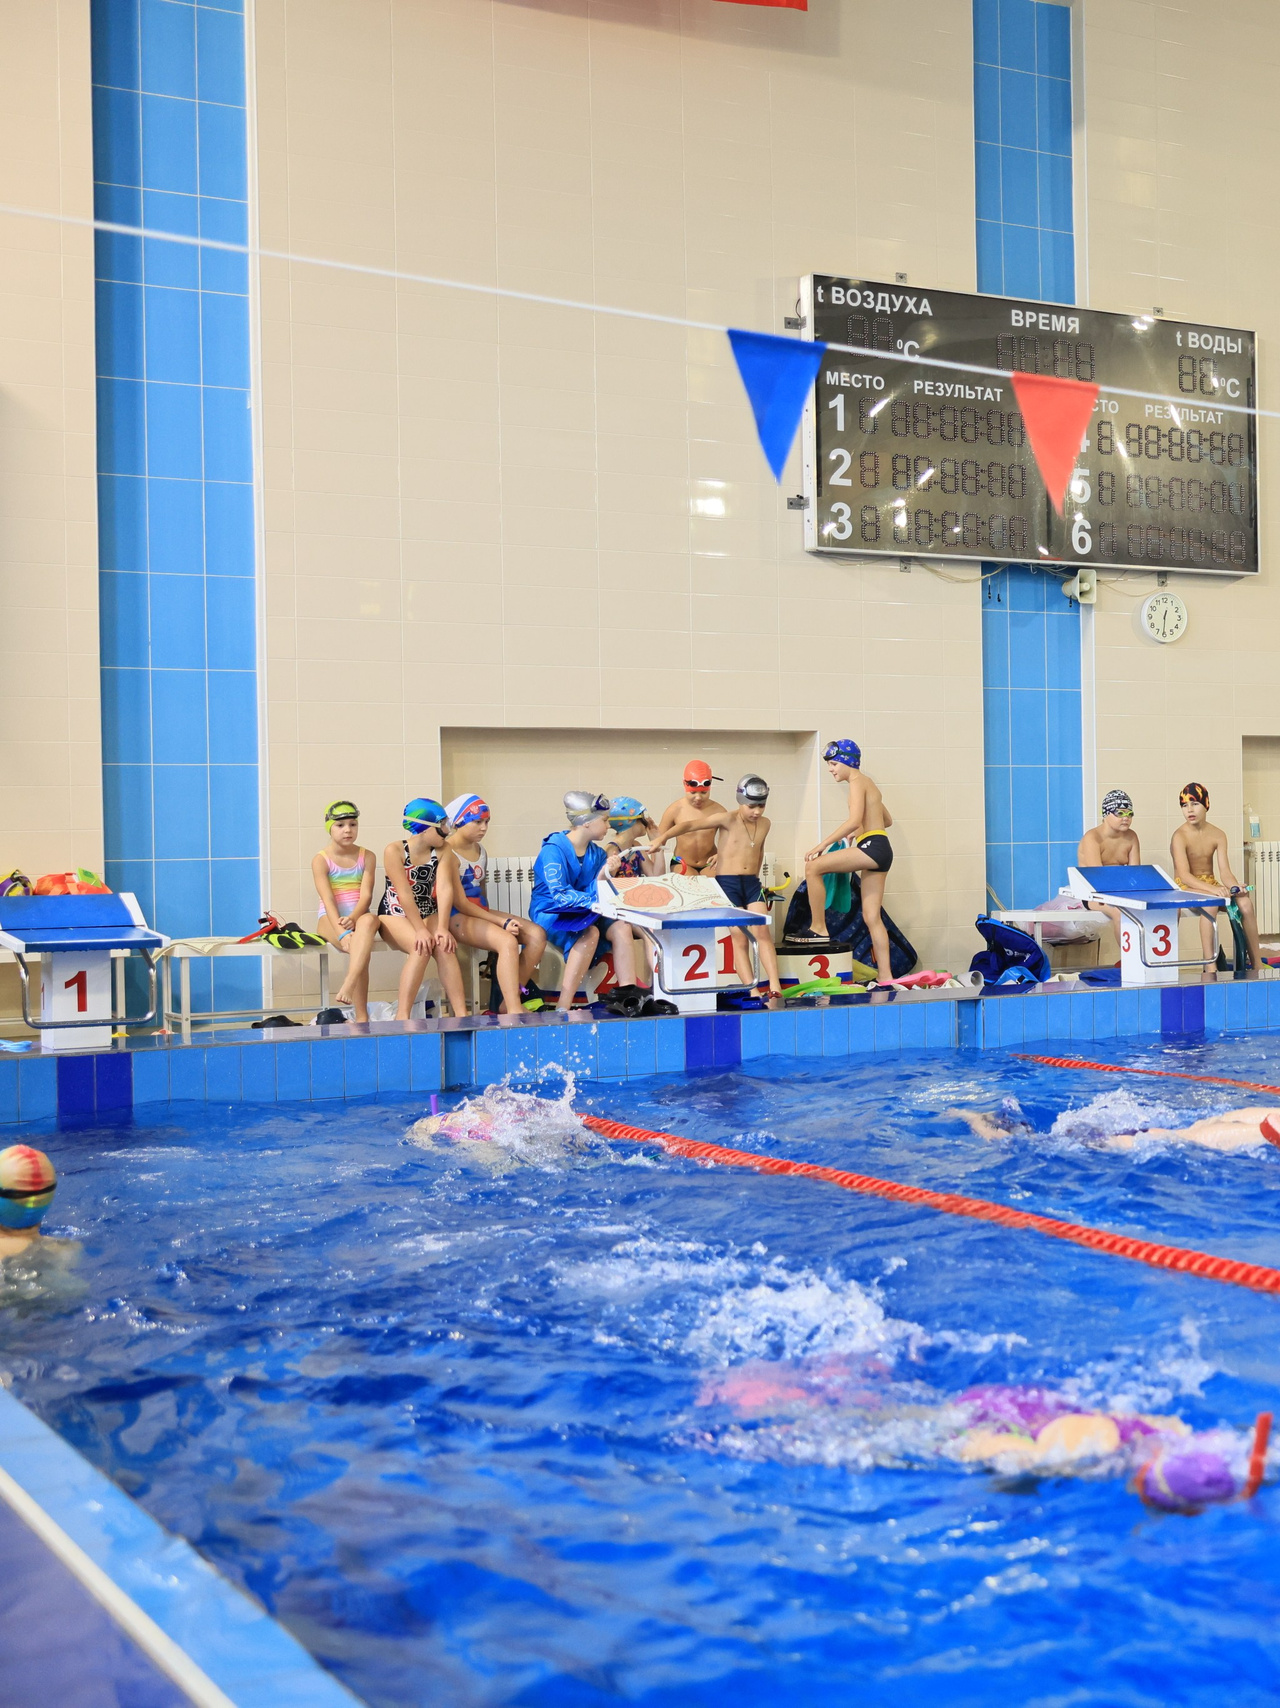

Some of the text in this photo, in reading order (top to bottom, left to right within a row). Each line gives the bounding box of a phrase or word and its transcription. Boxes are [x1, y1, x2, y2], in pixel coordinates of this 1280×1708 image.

[816, 285, 934, 316] t ВОЗДУХА
[1011, 309, 1080, 334] ВРЕМЯ
[1176, 331, 1242, 355] t ВОДЫ
[826, 370, 1004, 402] МЕСТО РЕЗУЛЬТАТ
[828, 393, 845, 431] 1
[828, 448, 852, 487] 2
[1071, 468, 1092, 504] 5
[829, 501, 853, 541] 3
[1071, 518, 1092, 554] 6
[717, 935, 737, 974] 1
[1122, 924, 1172, 957] 3 3
[682, 944, 710, 981] 2
[64, 970, 88, 1012] 1
